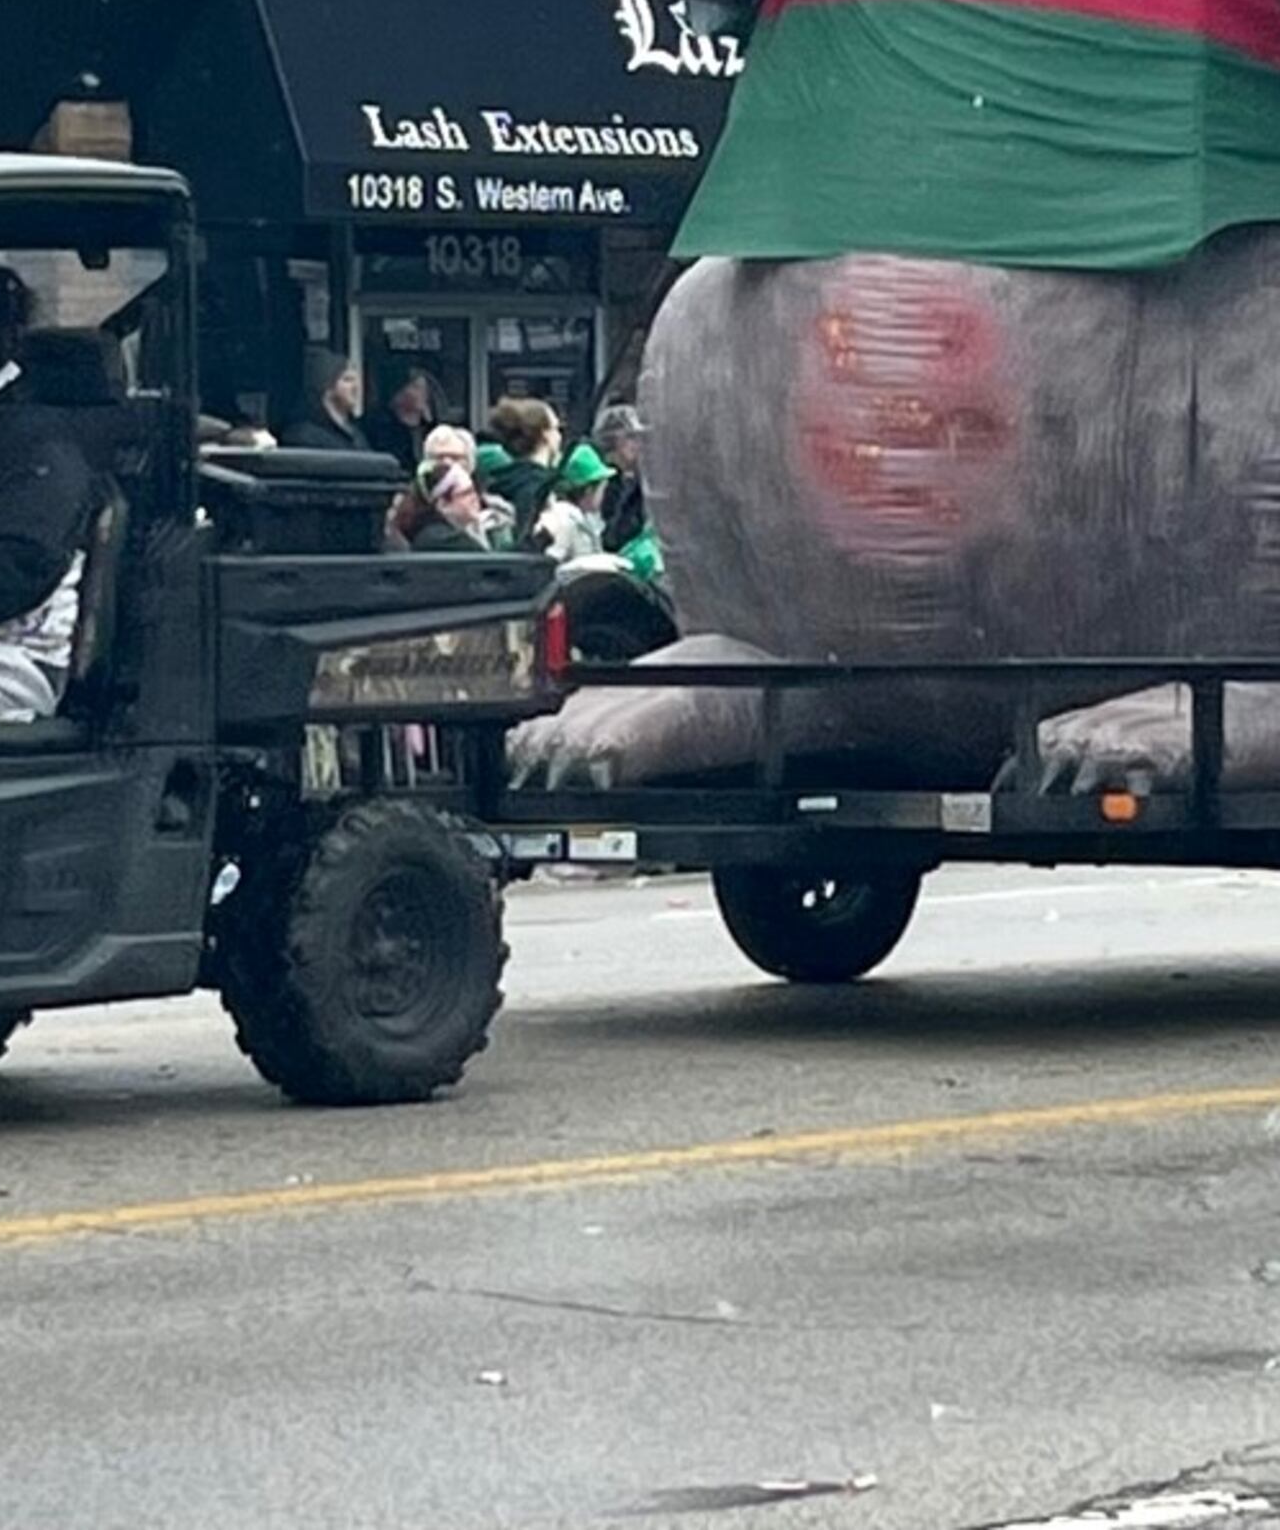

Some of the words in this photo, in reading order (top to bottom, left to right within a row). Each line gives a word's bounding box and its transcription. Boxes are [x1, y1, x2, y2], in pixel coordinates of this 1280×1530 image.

[361, 104, 470, 152] Lash
[480, 110, 701, 158] Extensions
[348, 174, 423, 210] 10318
[436, 176, 463, 210] S.
[476, 177, 574, 212] Western
[579, 179, 631, 214] Ave.
[425, 235, 522, 277] 10318
